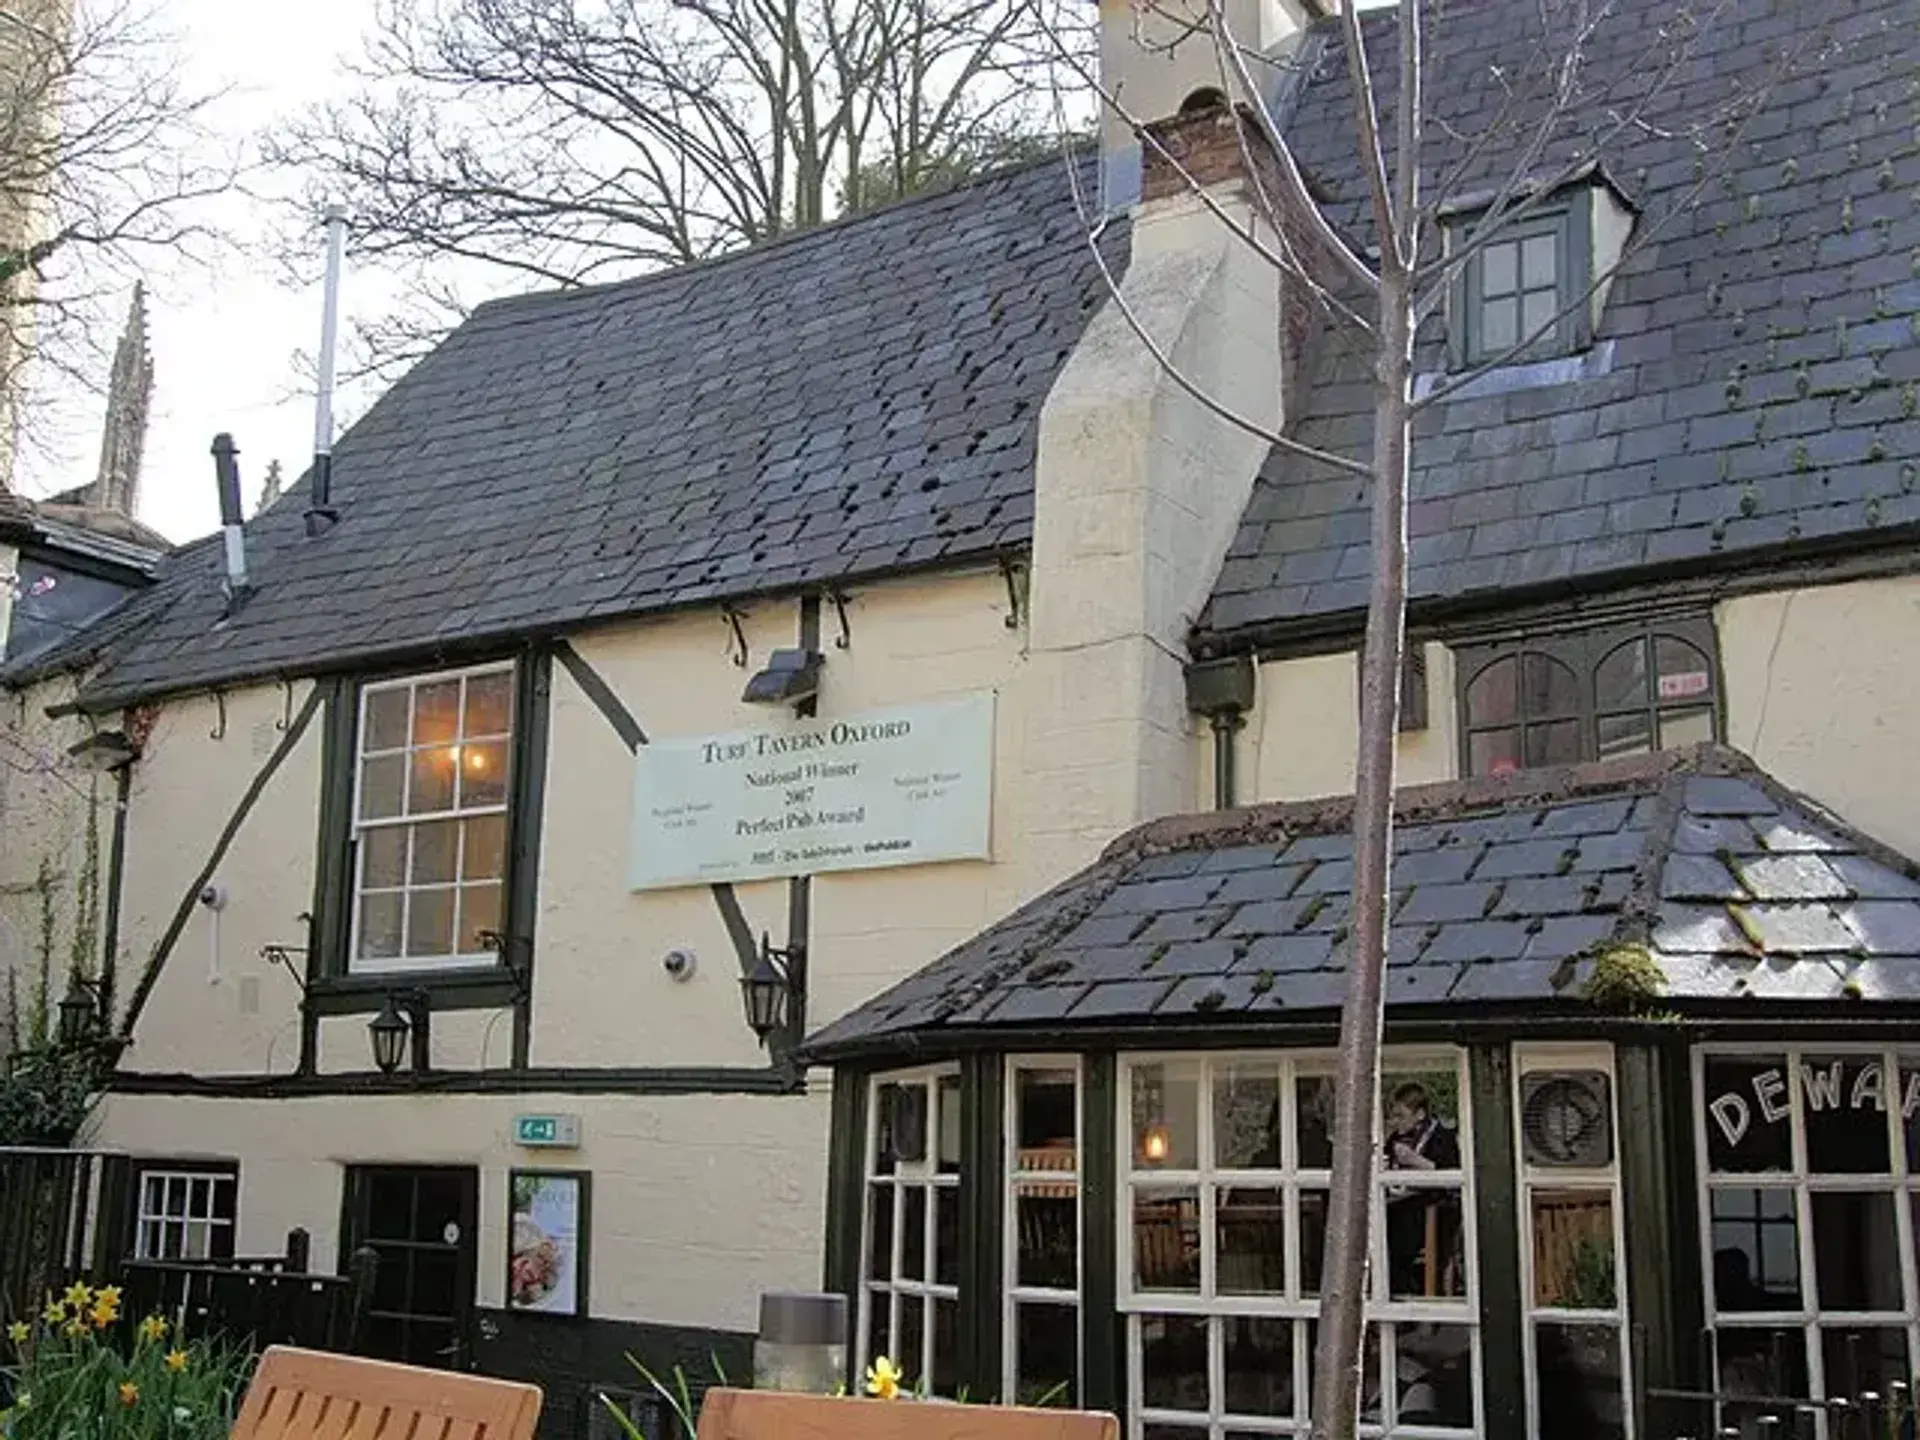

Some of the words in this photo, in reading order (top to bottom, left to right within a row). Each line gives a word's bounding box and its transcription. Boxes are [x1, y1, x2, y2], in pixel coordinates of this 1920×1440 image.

[753, 733, 827, 756] TAVERN
[831, 720, 912, 746] OXFORD
[746, 766, 801, 786] National
[804, 763, 859, 779] Winner
[735, 817, 784, 836] Perfect
[817, 806, 865, 825] Award
